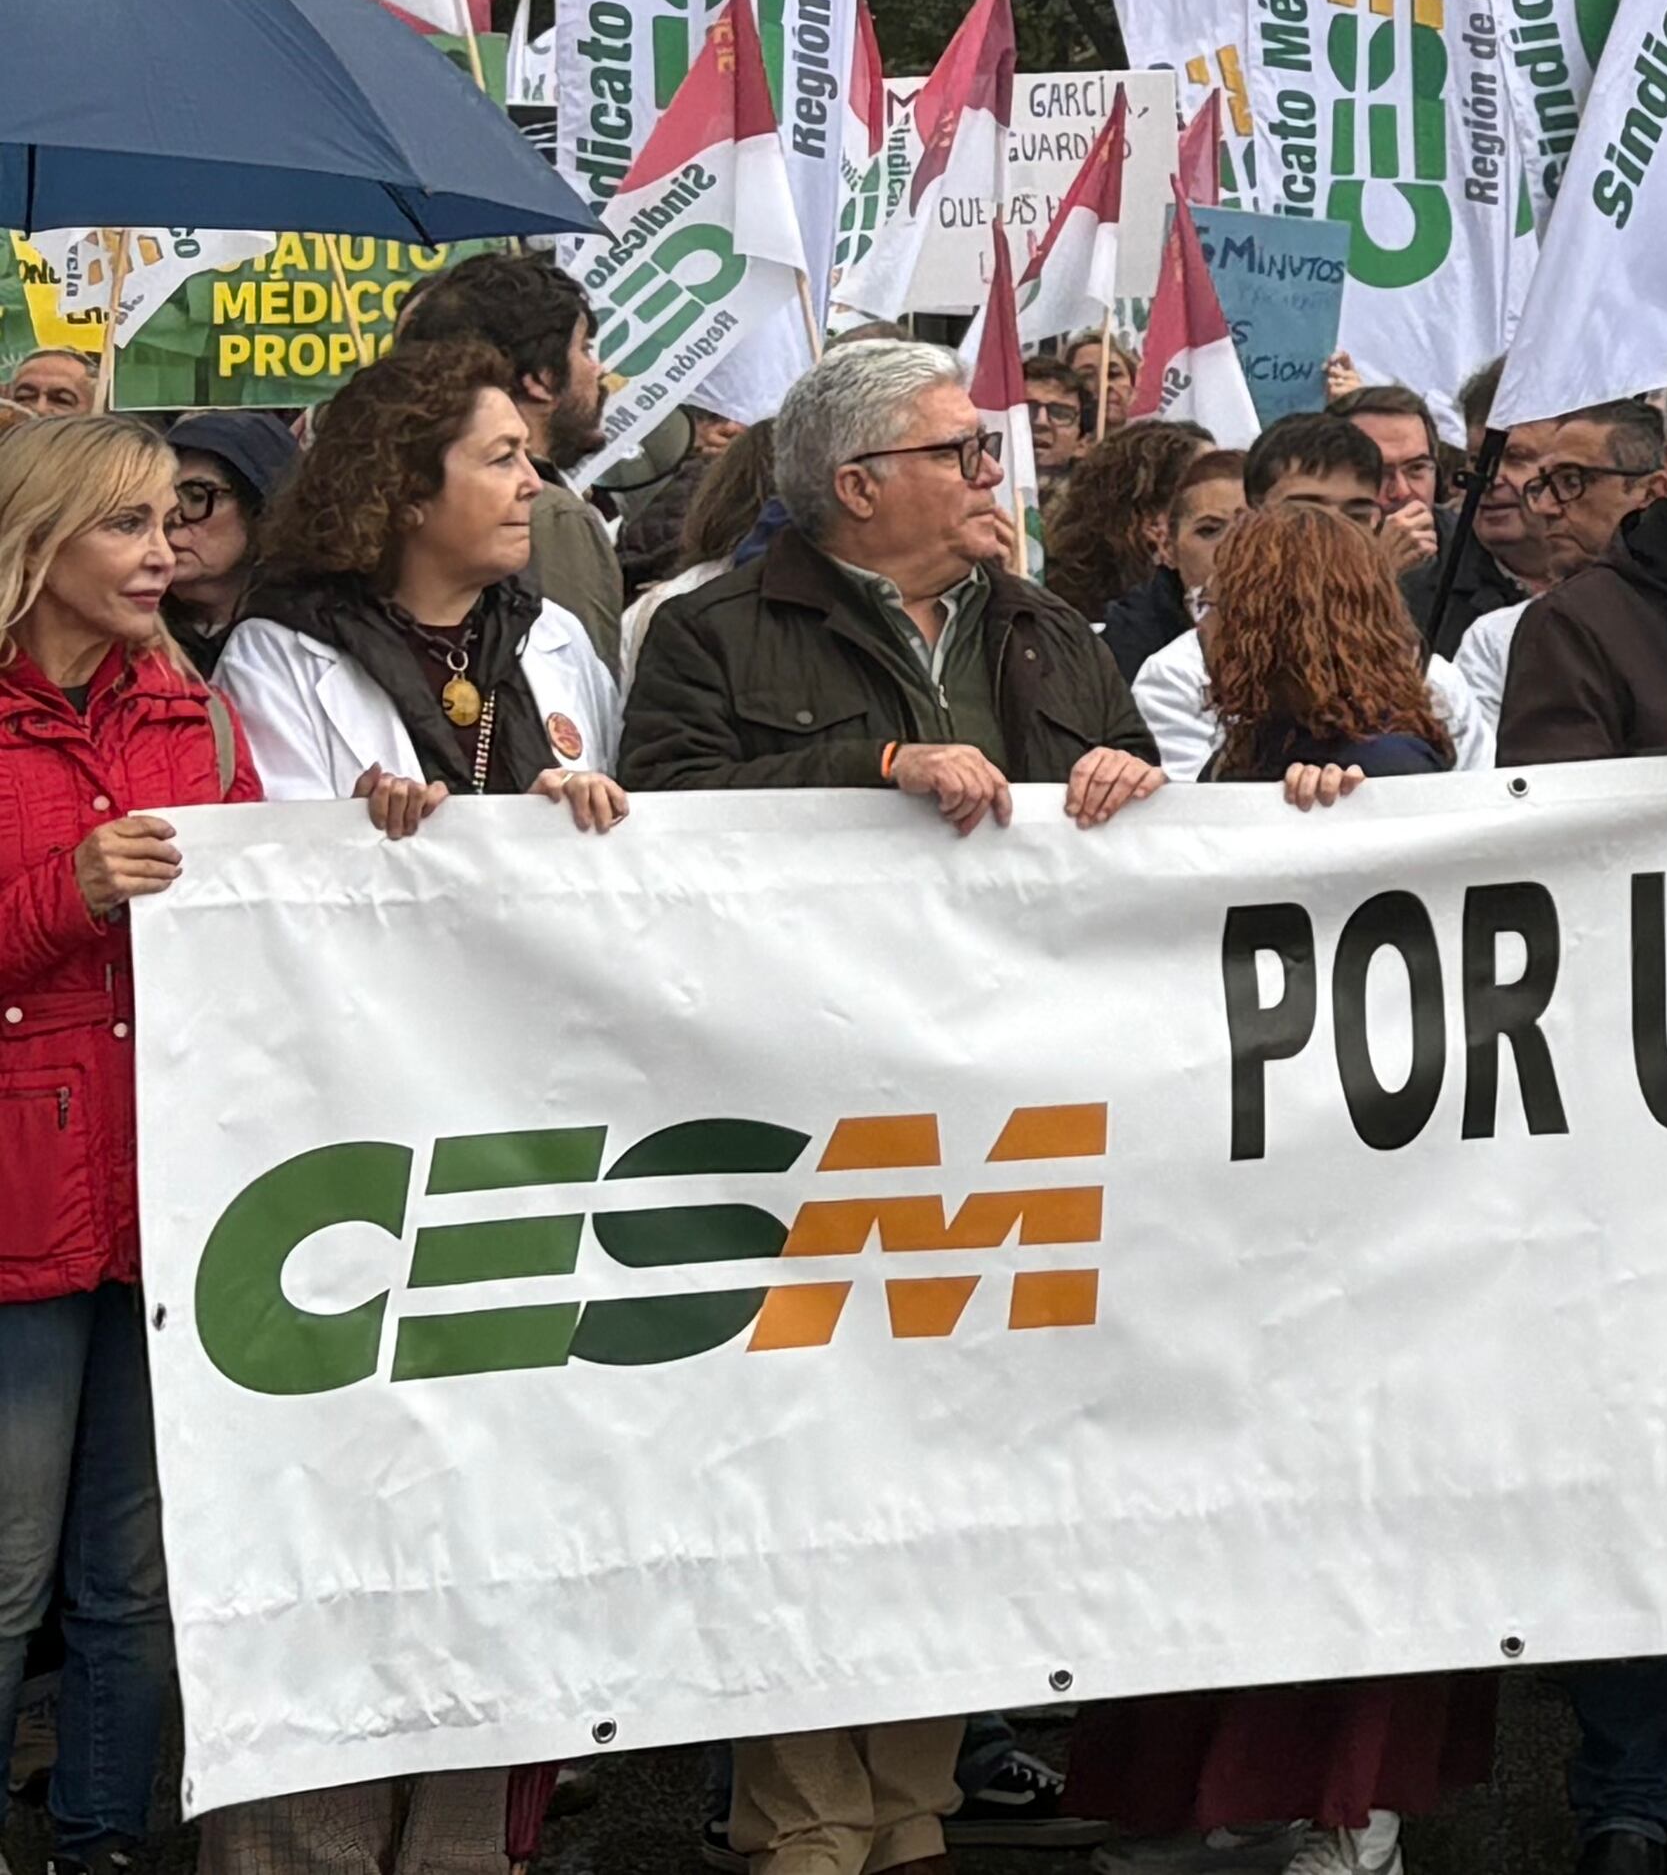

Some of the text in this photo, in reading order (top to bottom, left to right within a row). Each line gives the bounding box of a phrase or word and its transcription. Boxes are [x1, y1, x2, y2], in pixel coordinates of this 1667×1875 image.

[575, 1, 632, 218] dicato
[793, 0, 838, 159] Región
[1463, 12, 1497, 68] de
[940, 196, 987, 229] QUE
[1269, 89, 1318, 218] icato
[1465, 88, 1506, 205] Región
[1221, 881, 1570, 1160] POR
[196, 1102, 1108, 1395] CESM
